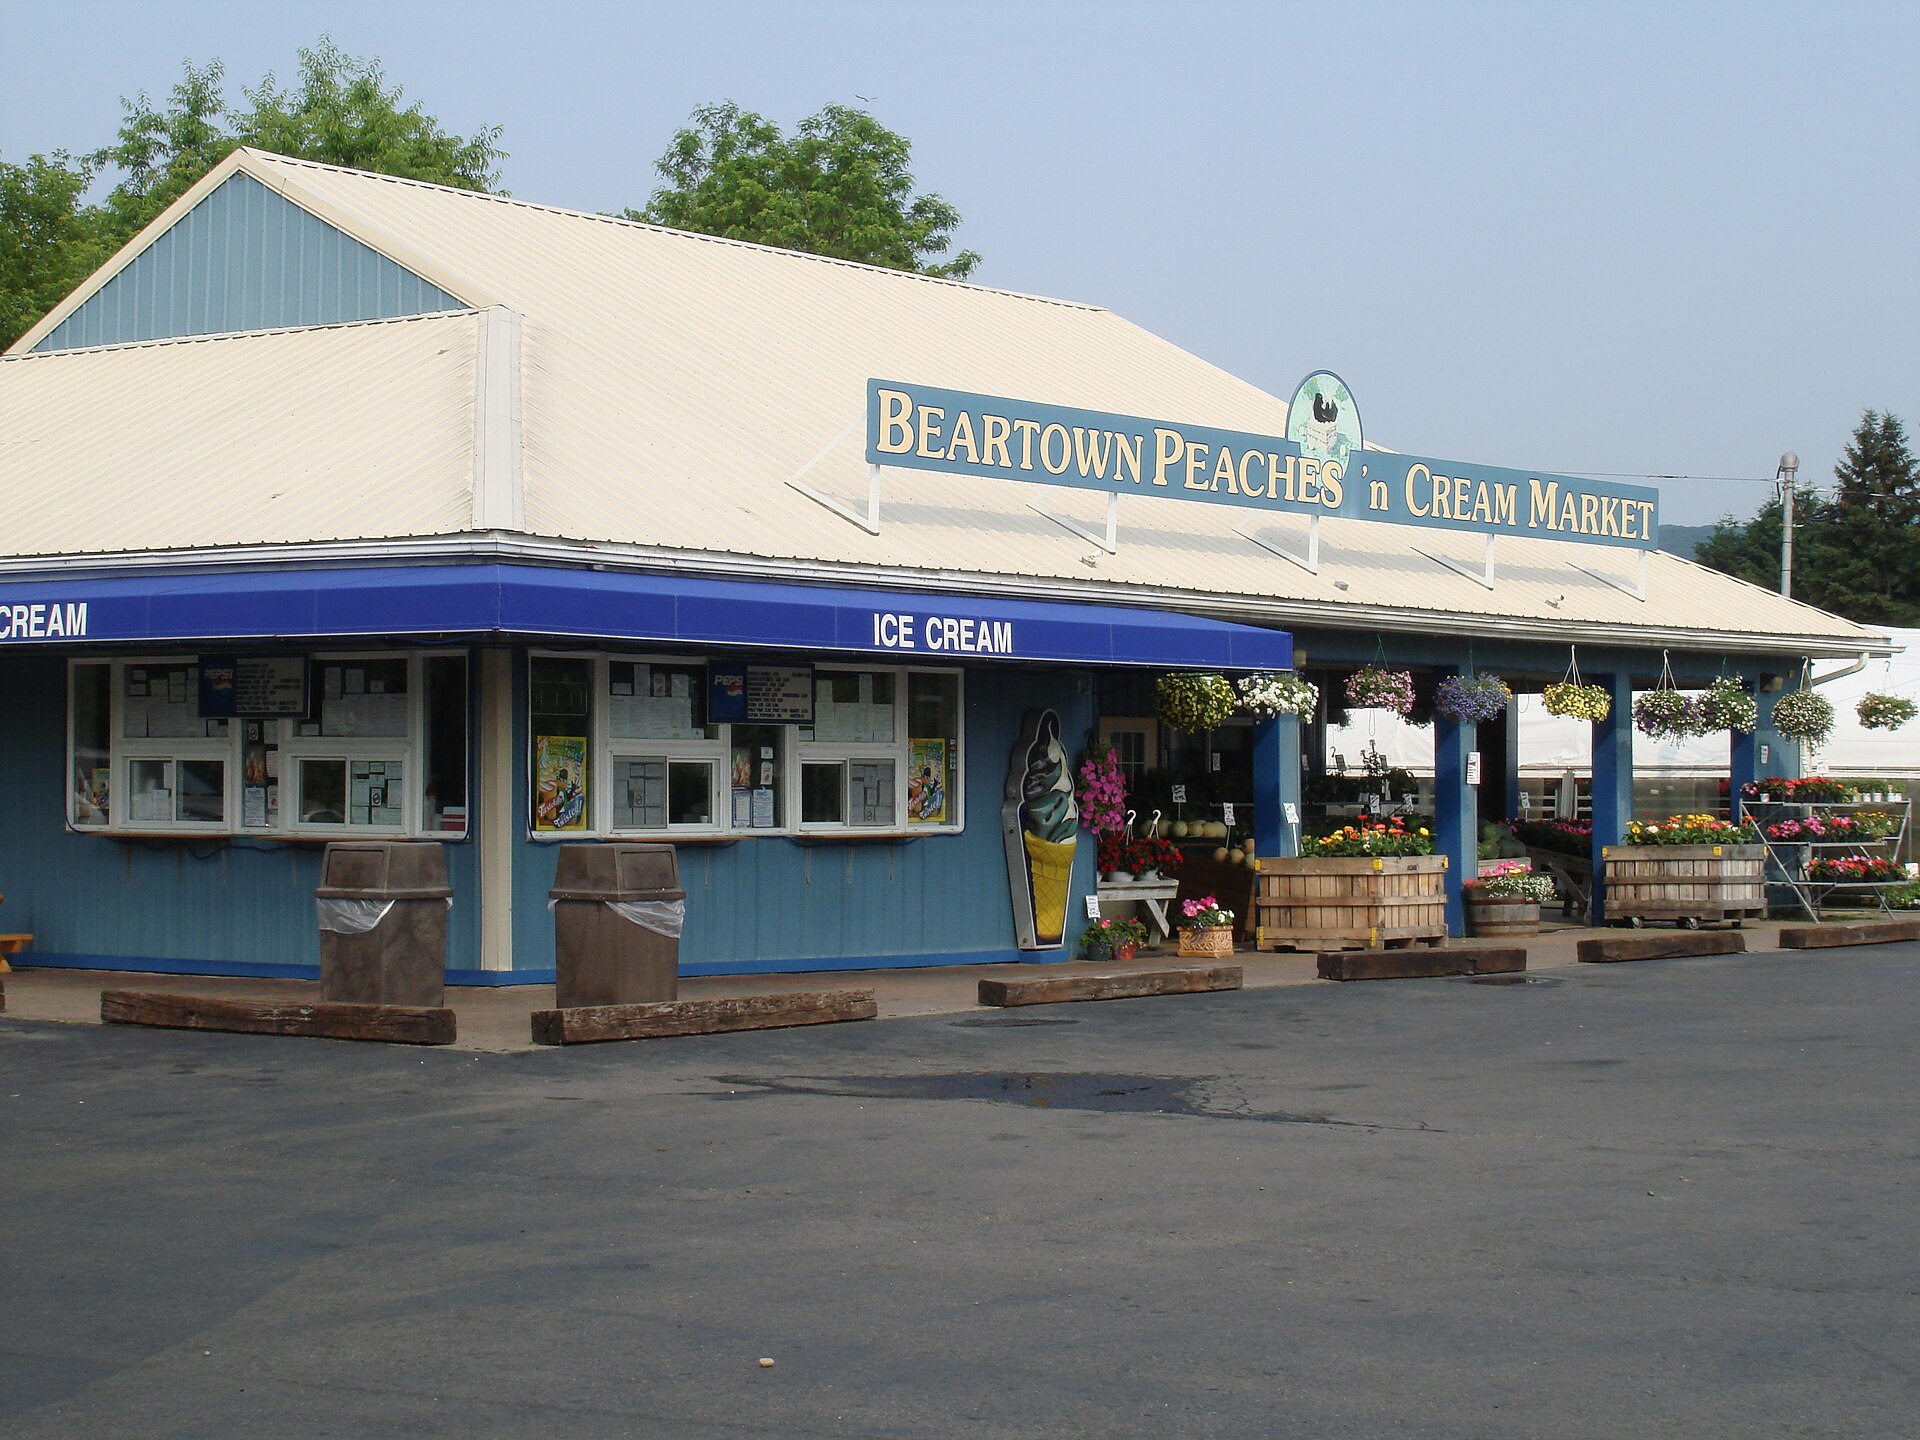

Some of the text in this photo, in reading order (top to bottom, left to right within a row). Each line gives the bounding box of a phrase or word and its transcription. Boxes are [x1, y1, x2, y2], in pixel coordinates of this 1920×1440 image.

[876, 388, 1654, 540] BEARTOWN PEACHES 'n CREAM MARKET
[0, 602, 88, 639] CREAM
[873, 613, 1013, 653] ICE CREAM
[204, 668, 234, 680] PEPSI
